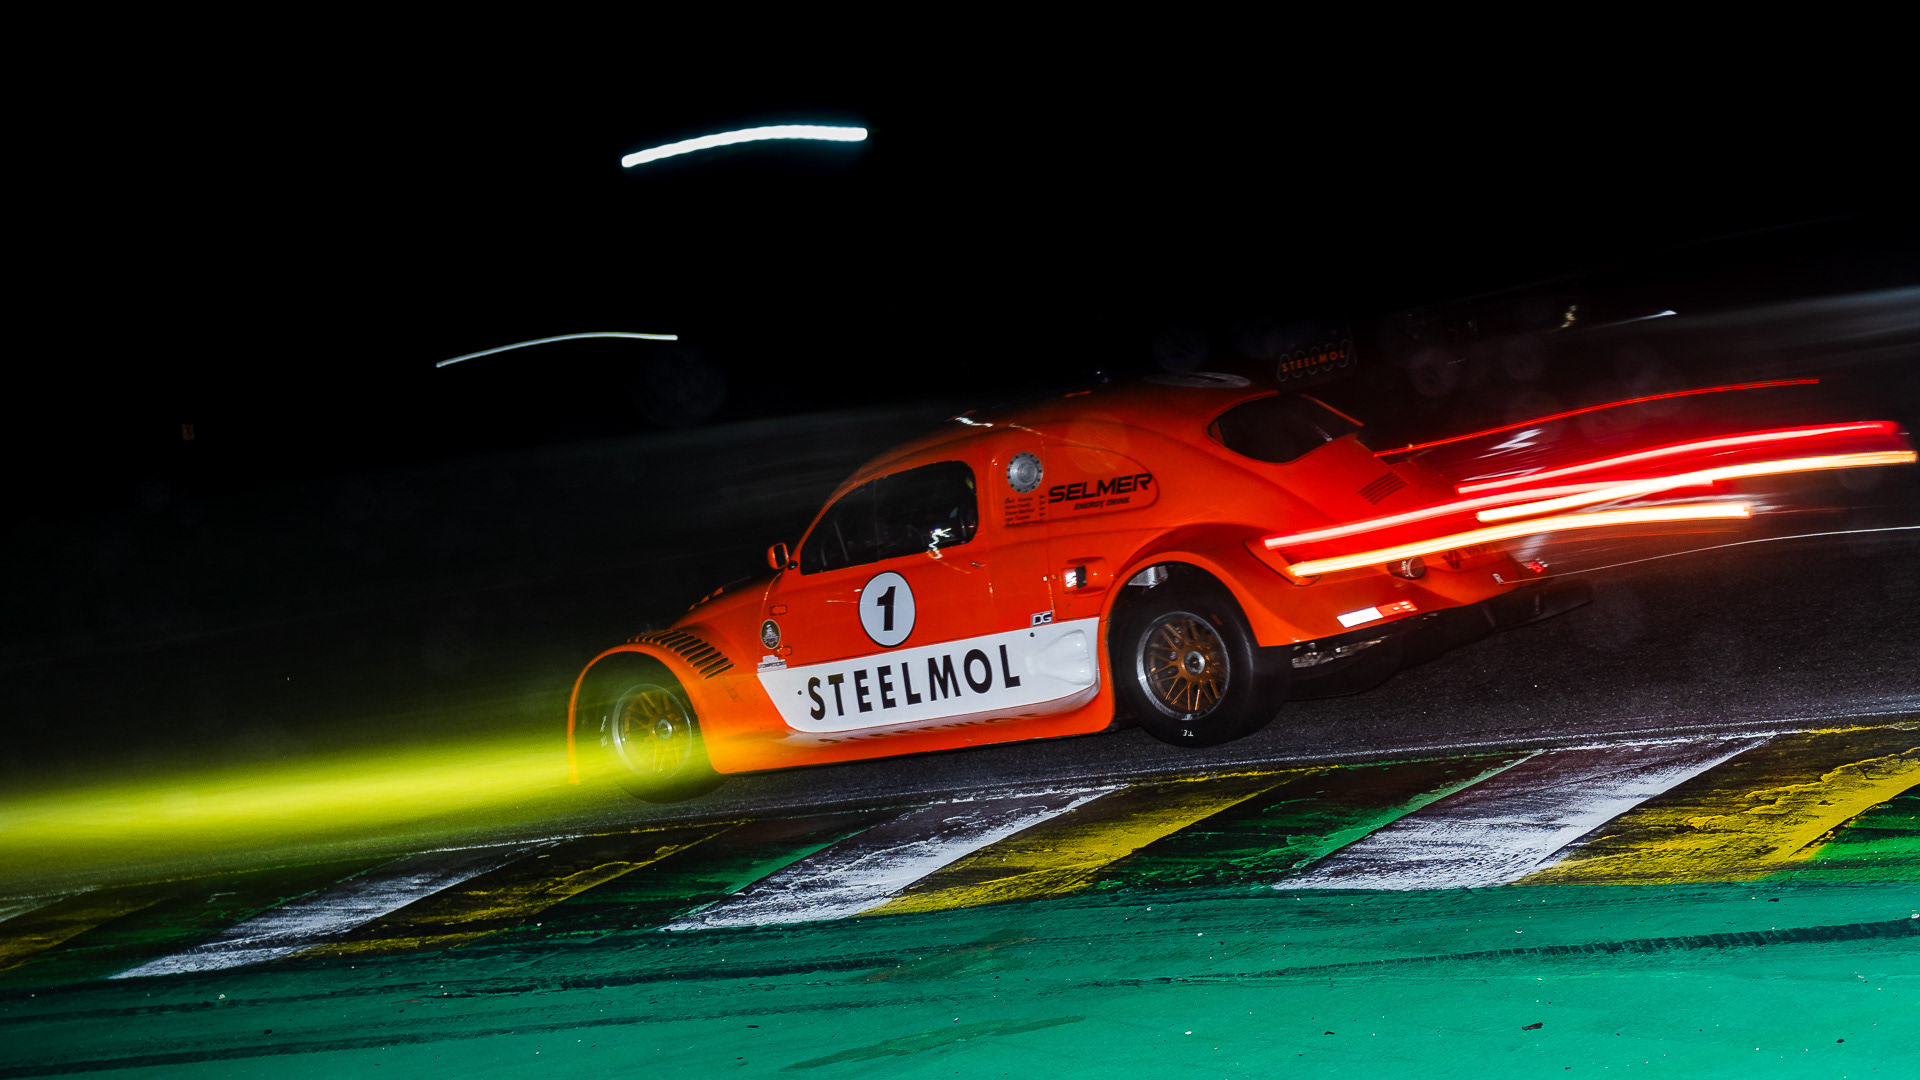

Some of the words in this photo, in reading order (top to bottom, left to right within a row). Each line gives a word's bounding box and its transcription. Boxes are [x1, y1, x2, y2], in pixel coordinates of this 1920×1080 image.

[1281, 349, 1345, 372] STEELMOL
[1049, 473, 1152, 503] SELMER
[1073, 501, 1104, 510] ENERGY
[1106, 497, 1130, 506] DRINK
[876, 586, 896, 631] 1
[1032, 612, 1052, 626] DG
[807, 644, 1021, 721] STEELMOL
